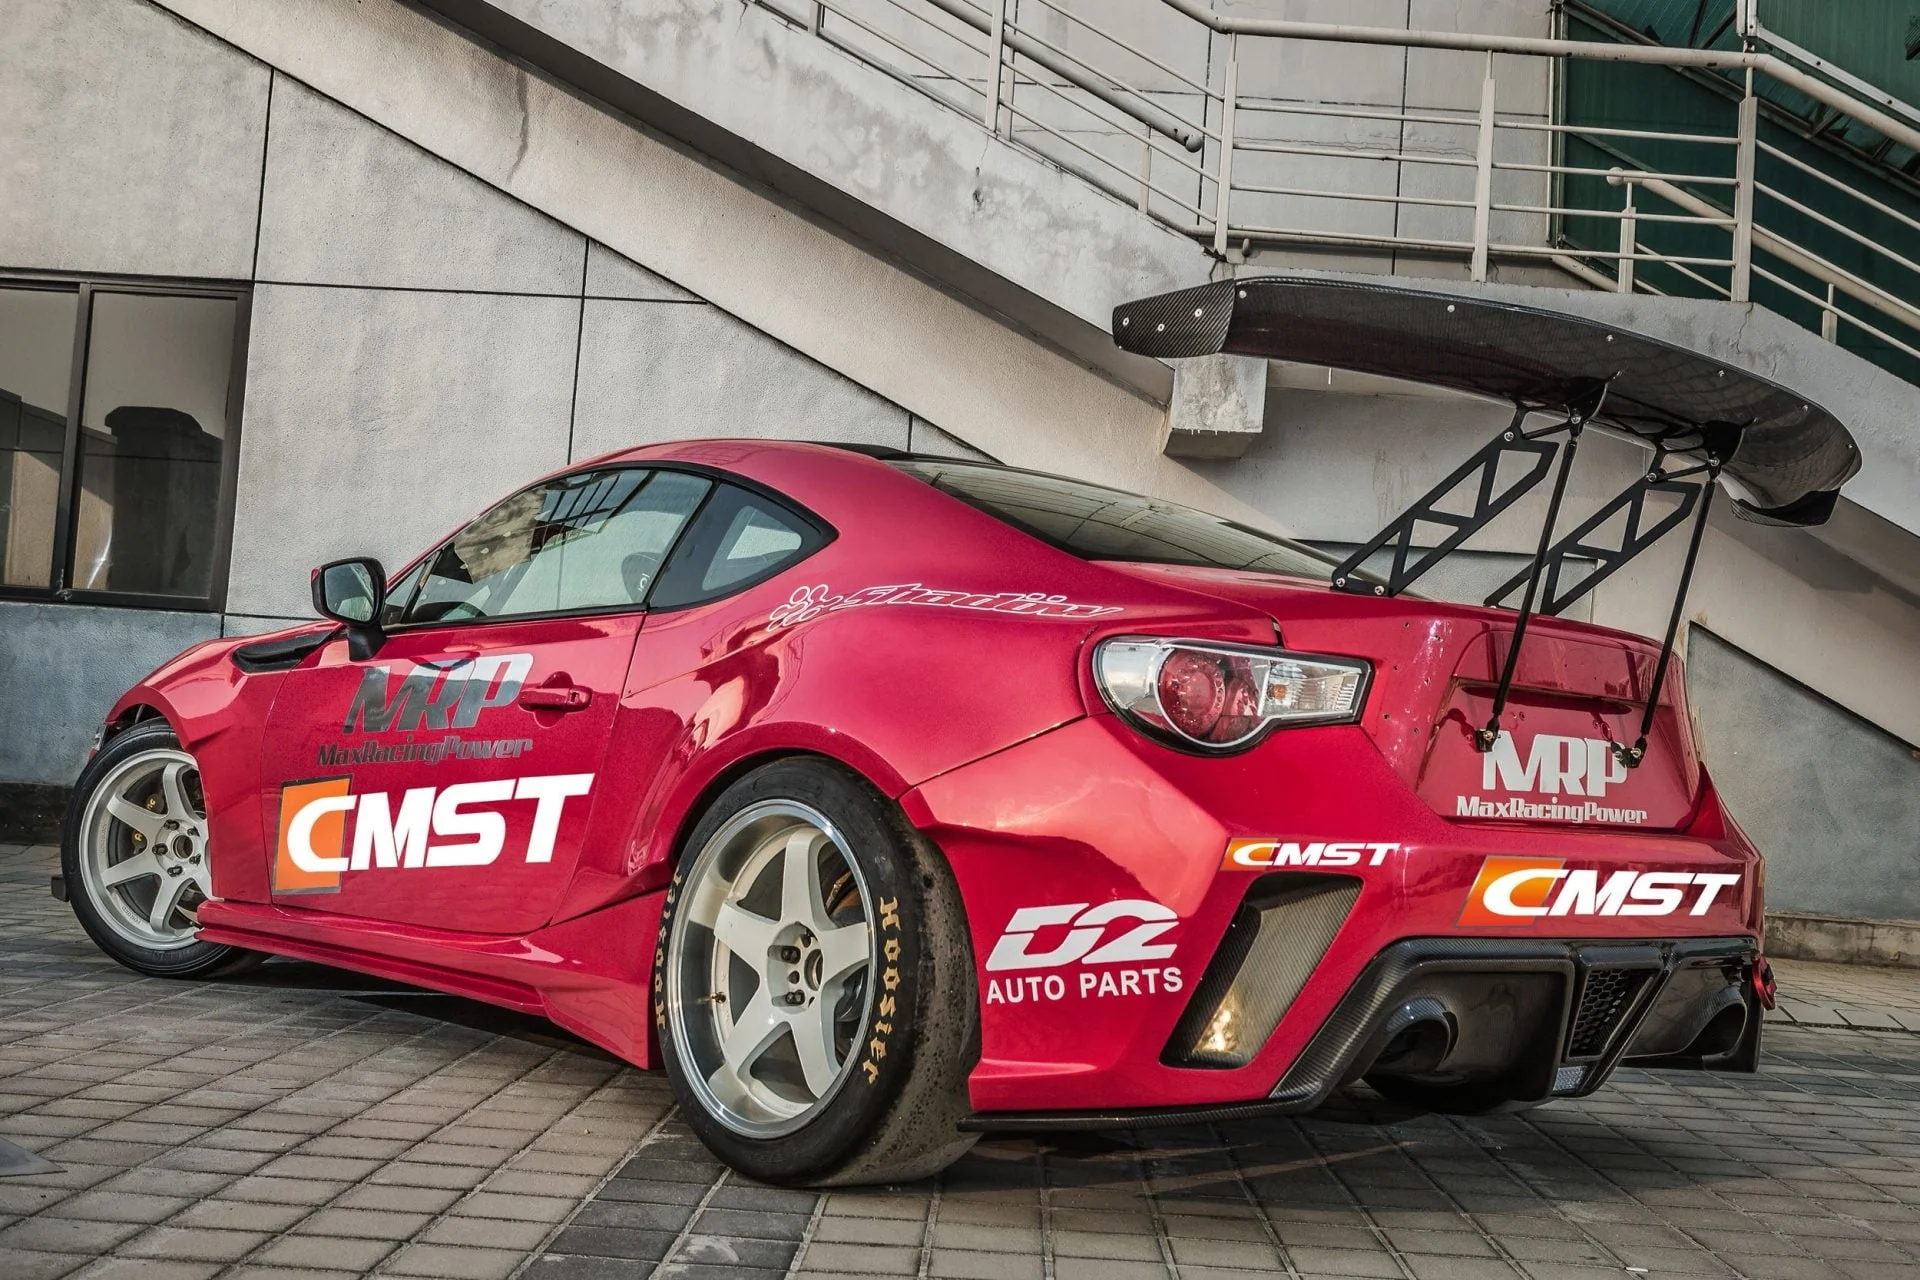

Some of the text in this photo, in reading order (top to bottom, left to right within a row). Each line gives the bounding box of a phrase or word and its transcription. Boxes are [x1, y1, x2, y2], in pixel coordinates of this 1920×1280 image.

[343, 653, 534, 735] MRP
[317, 735, 534, 766] MaxRacingPower
[1482, 729, 1629, 797] MRP
[287, 773, 595, 873] CMST
[1456, 795, 1648, 825] MaxRacingPower
[1232, 842, 1401, 867] CMST
[1483, 868, 1741, 916] CMST
[985, 899, 1180, 972] D2
[986, 967, 1184, 1005] AUTO PARTS
